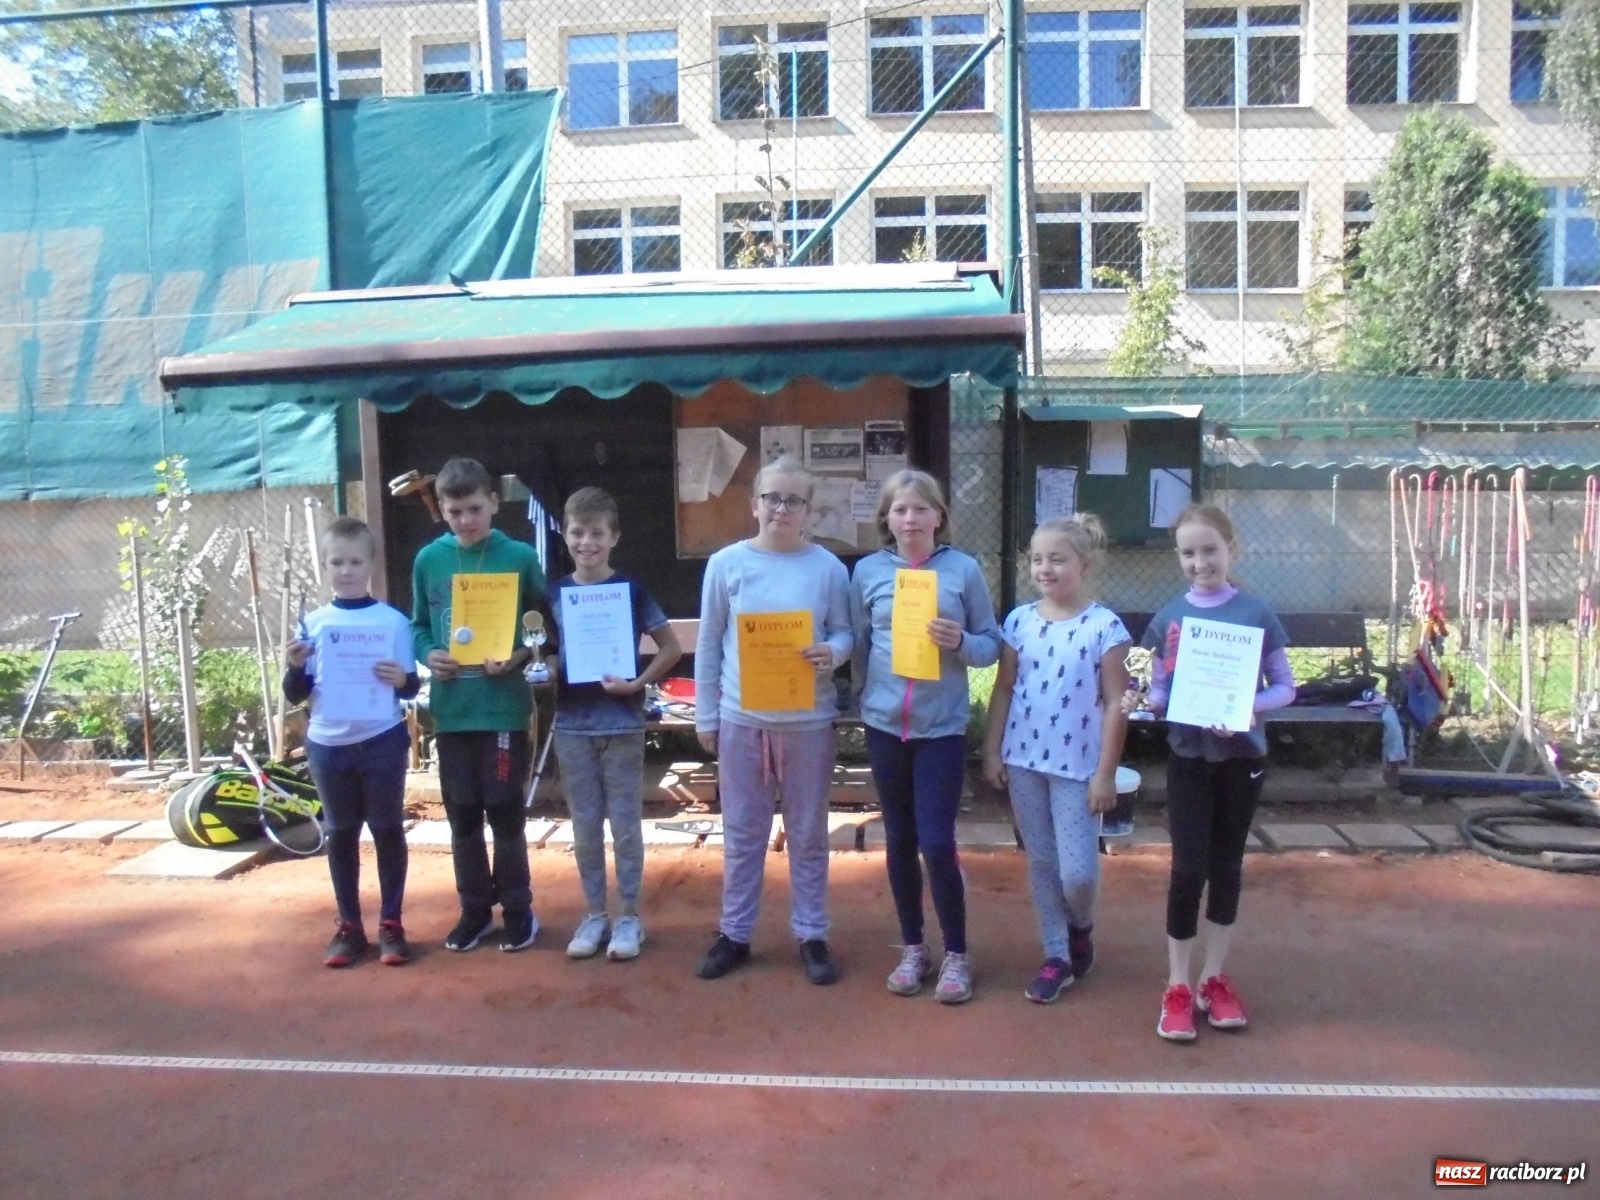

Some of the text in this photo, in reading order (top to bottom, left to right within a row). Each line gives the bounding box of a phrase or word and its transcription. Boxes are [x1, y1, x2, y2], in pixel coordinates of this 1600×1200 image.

[581, 592, 622, 603] DYPLOM
[759, 620, 804, 631] DYPLOM
[343, 633, 386, 642] DYPLOM
[1204, 629, 1252, 645] DYPLOM
